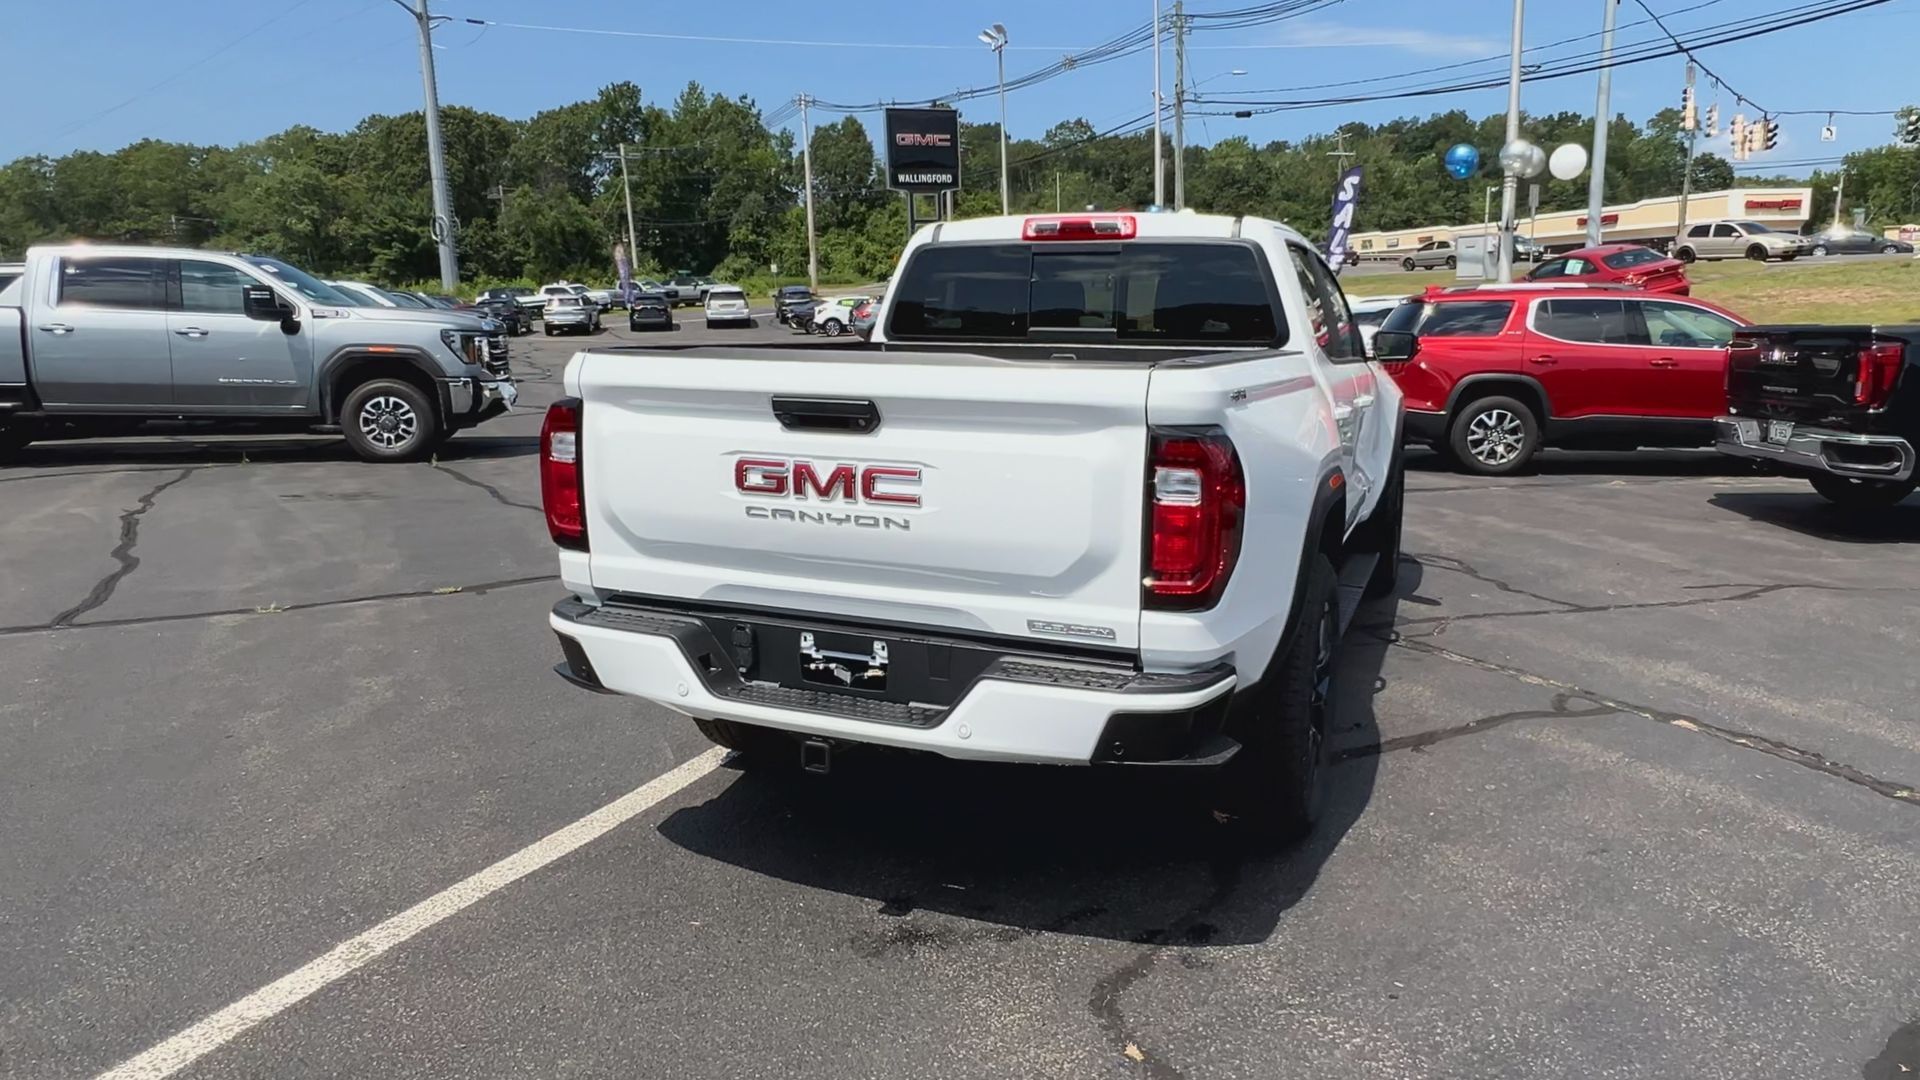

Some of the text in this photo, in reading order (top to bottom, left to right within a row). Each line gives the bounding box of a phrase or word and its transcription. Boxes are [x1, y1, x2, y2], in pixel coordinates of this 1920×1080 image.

[896, 133, 951, 146] GMC
[898, 174, 953, 183] WALLINGFORD
[735, 457, 923, 508] GMC
[745, 505, 911, 530] CANYON
